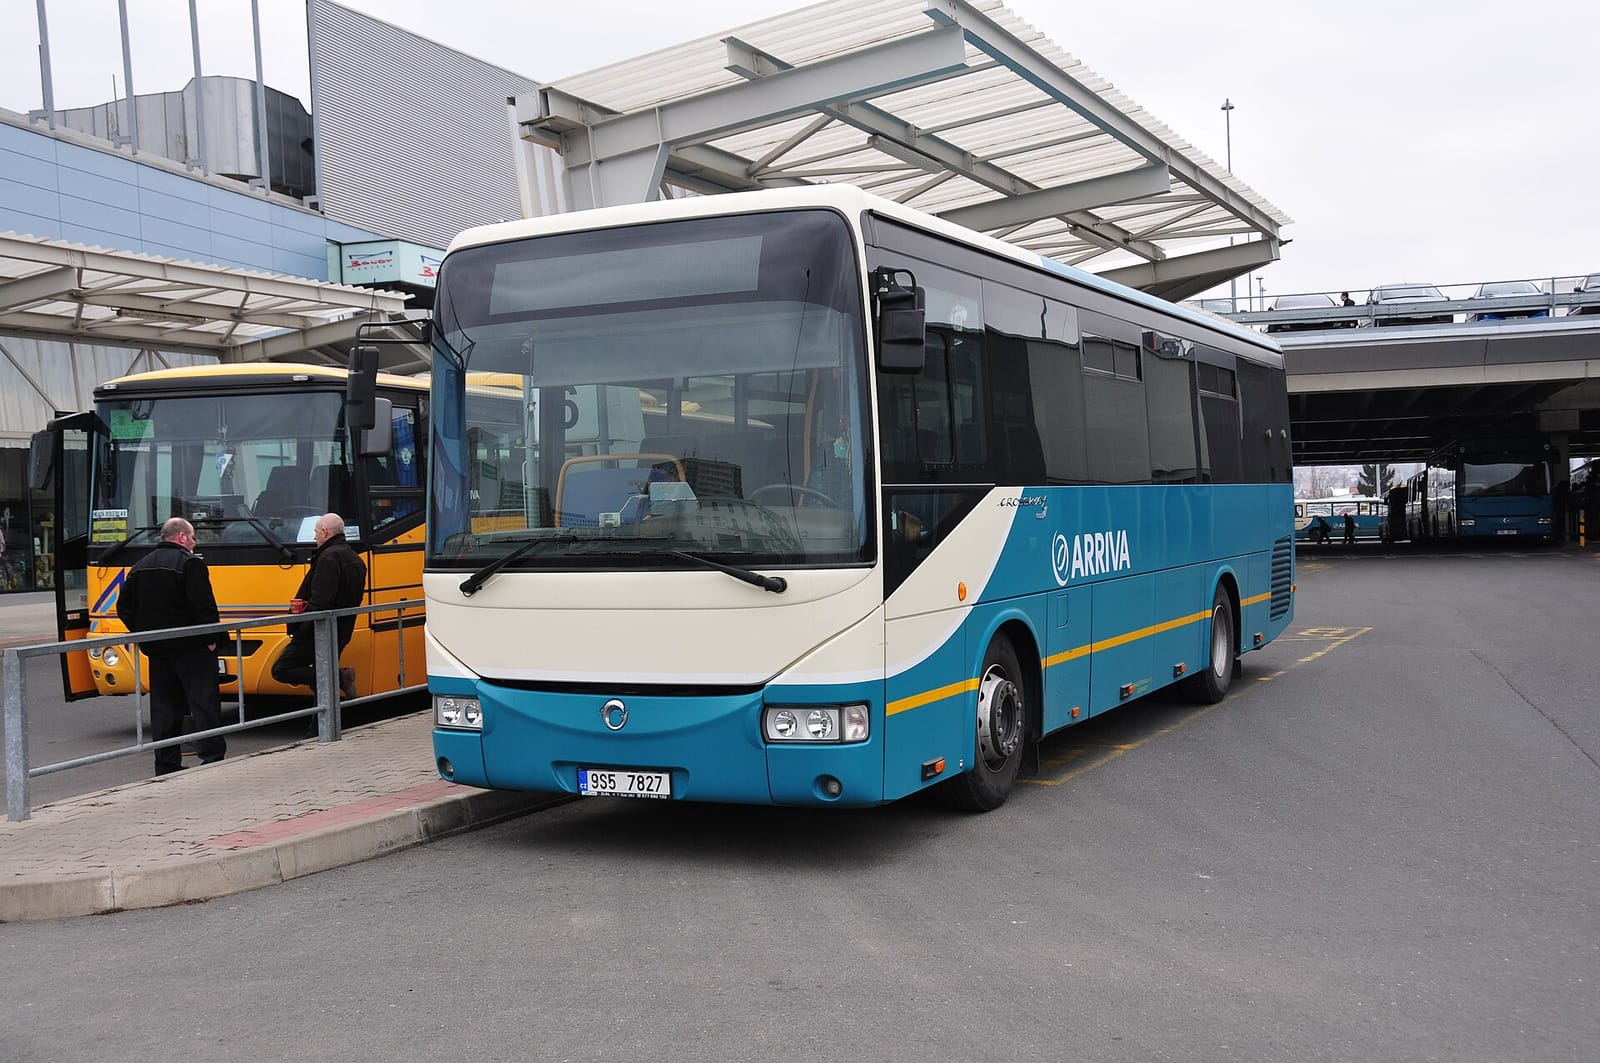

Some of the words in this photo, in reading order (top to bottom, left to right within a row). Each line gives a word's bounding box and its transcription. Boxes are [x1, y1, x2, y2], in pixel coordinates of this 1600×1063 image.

[1071, 530, 1131, 579] ARRIVA
[591, 773, 616, 790] 9S5
[627, 774, 662, 793] 7827
